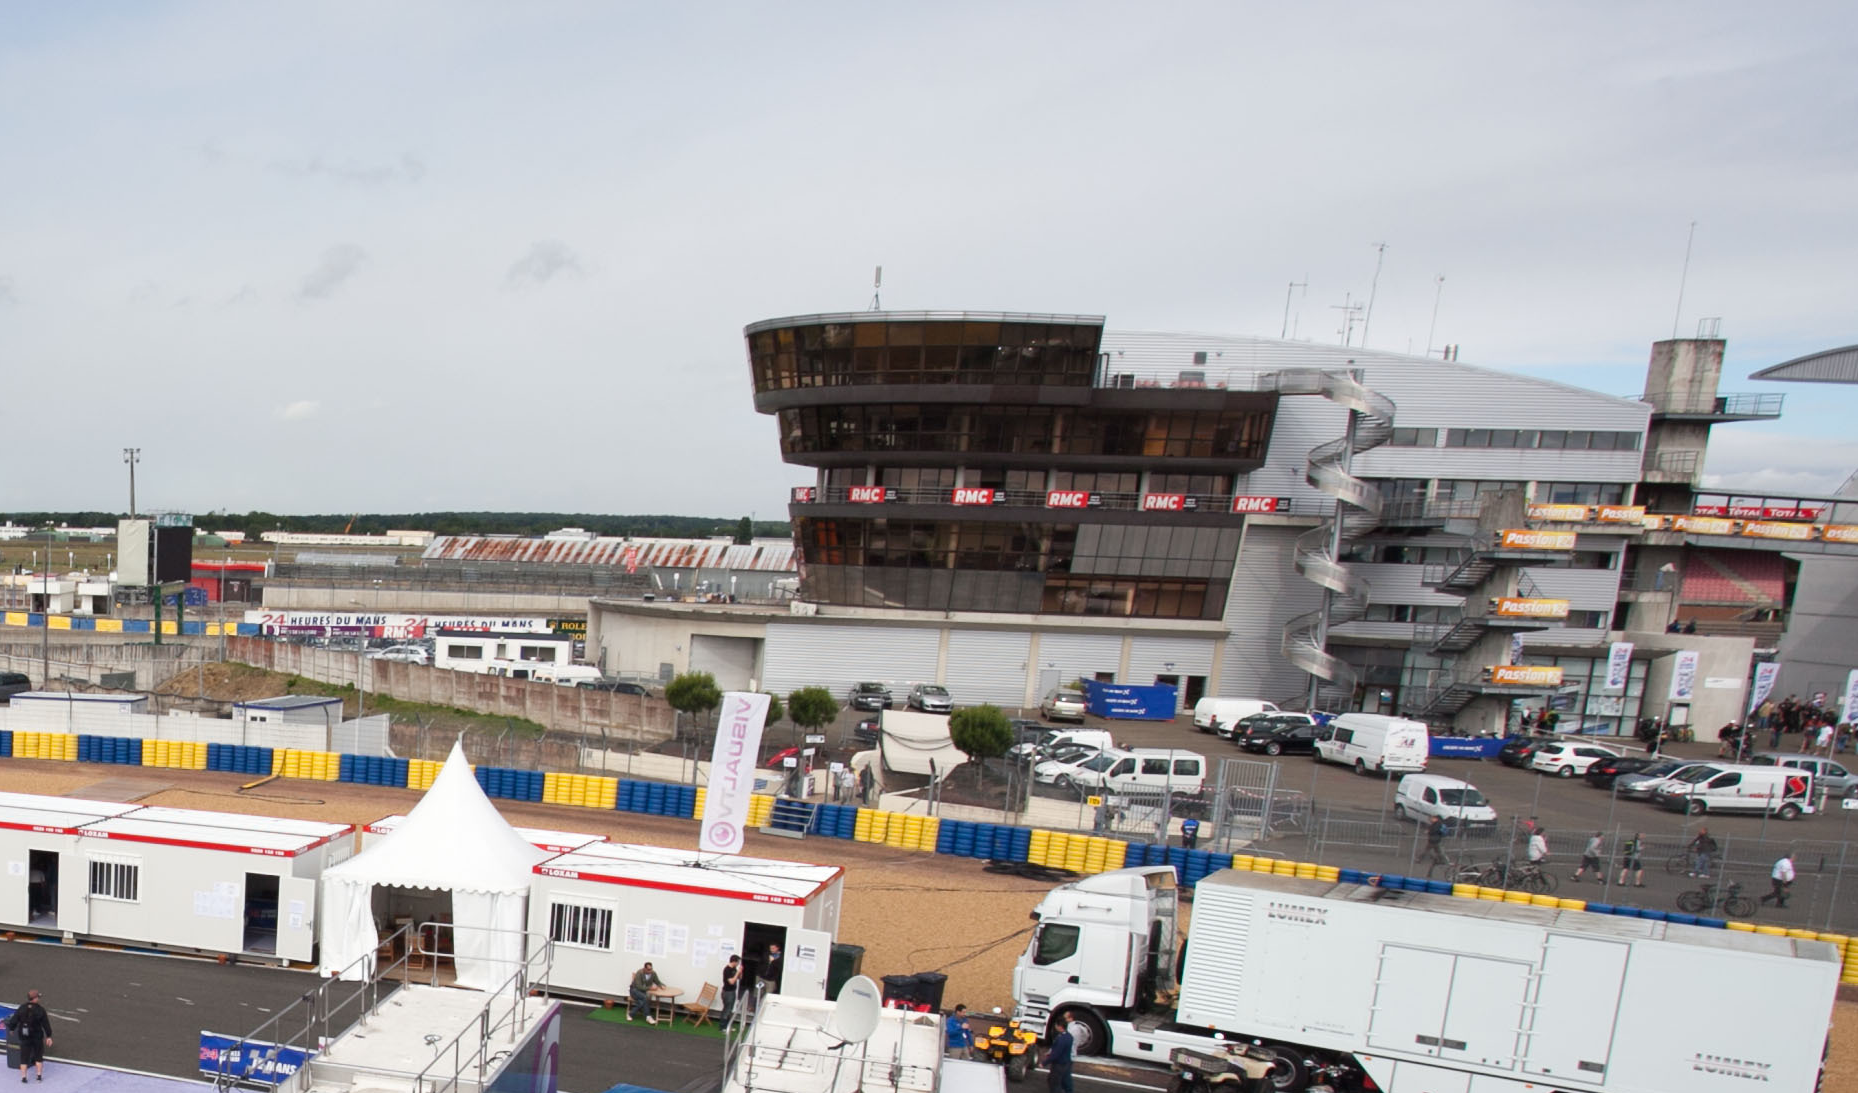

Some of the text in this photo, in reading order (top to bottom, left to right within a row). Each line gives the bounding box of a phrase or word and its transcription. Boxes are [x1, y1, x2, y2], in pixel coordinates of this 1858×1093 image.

[851, 488, 880, 500] RMC
[955, 490, 988, 503] RMC
[1048, 493, 1084, 506] RMC
[1145, 496, 1178, 509] RMC
[1236, 499, 1271, 511] RMC
[1506, 532, 1556, 546] Passion
[1501, 600, 1551, 613] Passion
[261, 614, 387, 625] 24 HEURES DU MANS
[1497, 669, 1545, 682] Passion
[84, 830, 109, 838] LOXAM
[549, 868, 579, 879] LOXAM
[1268, 902, 1328, 926] LUMEX
[199, 1046, 218, 1060] 24
[1693, 1052, 1772, 1082] LUMEX
